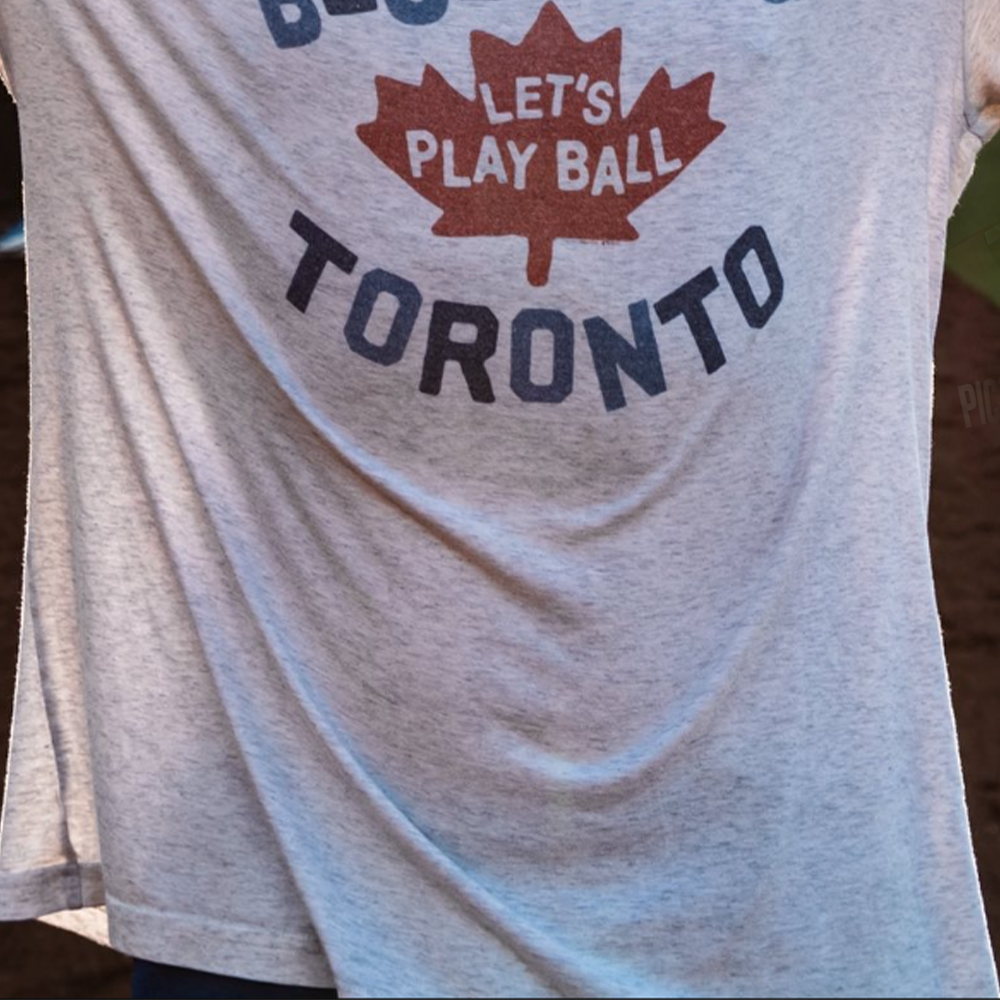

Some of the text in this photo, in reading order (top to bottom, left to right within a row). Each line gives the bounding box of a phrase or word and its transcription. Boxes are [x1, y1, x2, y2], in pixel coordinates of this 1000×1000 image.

[479, 73, 614, 125] LET'S
[405, 127, 682, 196] PLAY BALL
[286, 210, 784, 412] TORONTO
